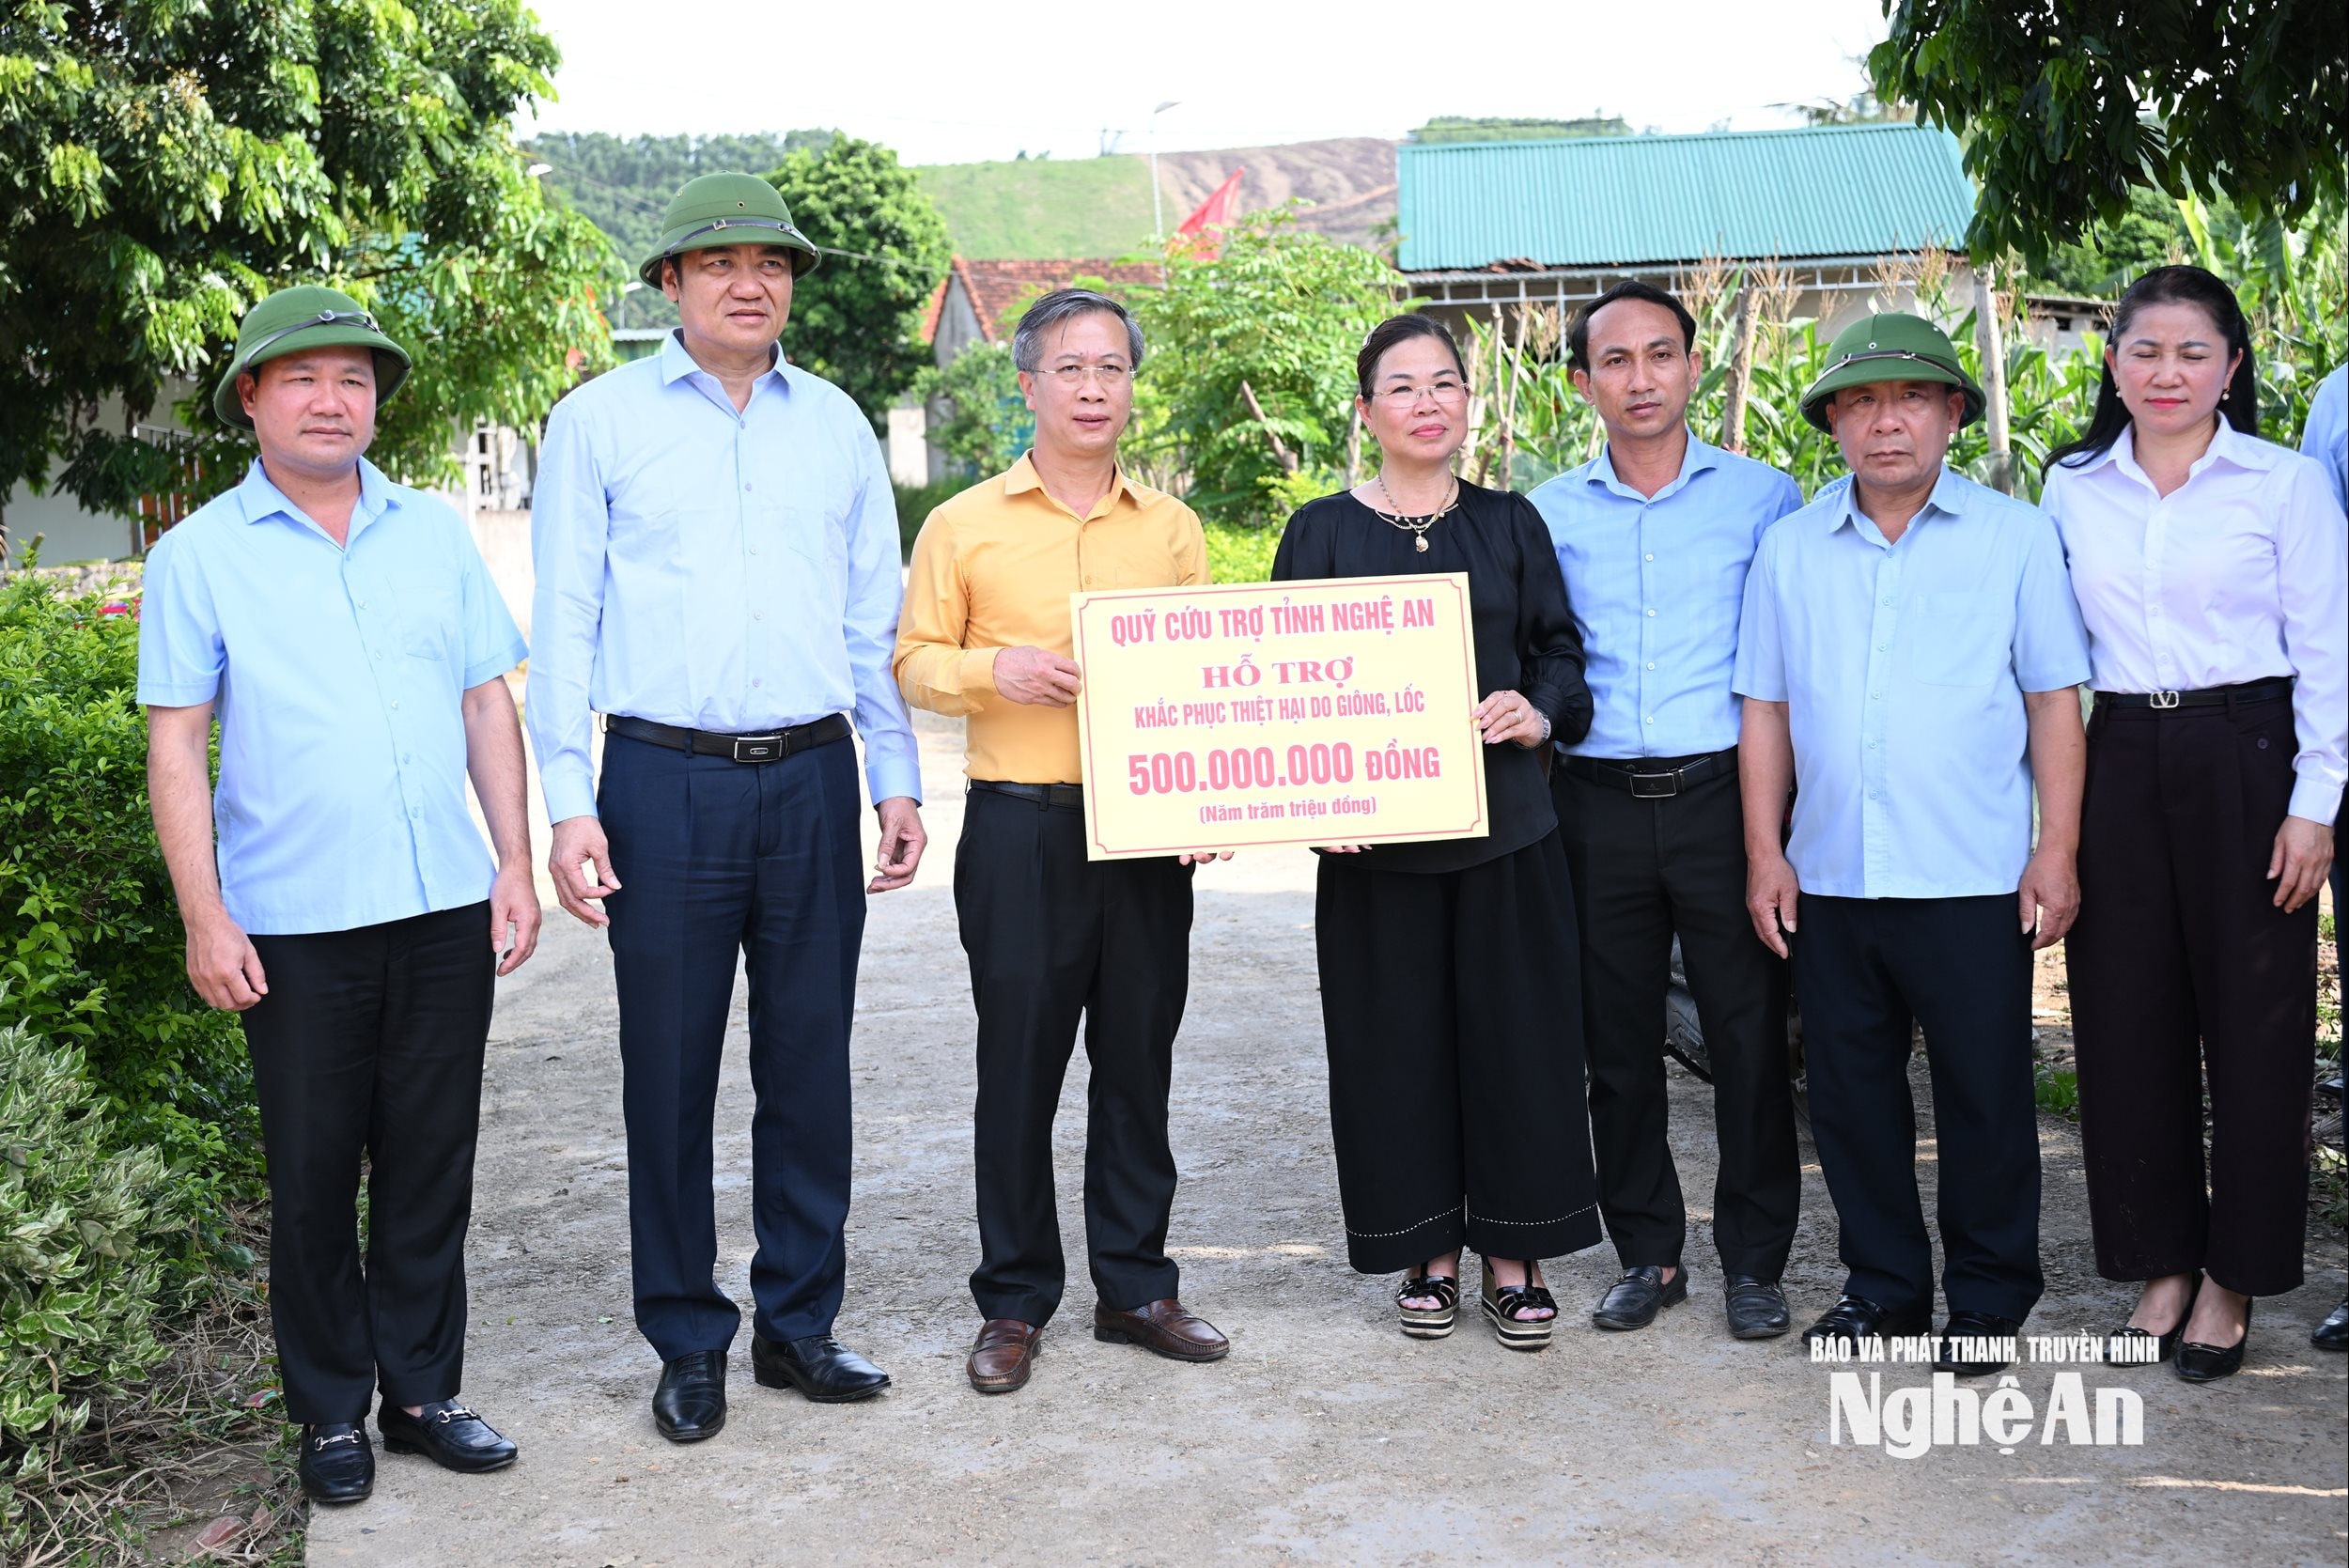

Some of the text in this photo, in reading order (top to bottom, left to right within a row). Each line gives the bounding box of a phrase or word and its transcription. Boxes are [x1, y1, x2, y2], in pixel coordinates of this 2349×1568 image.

[1112, 595, 1434, 646] QUỸ CỨU TRỢ TỈNH NGHỆ AN
[1203, 654, 1353, 689] HỖ TRỢ
[1135, 684, 1424, 729] KHẮC PHỤC THIỆT HẠI DO GIÔNG, LỐC
[1128, 738, 1440, 797] 500.000.000 ĐỒNG
[1200, 796, 1376, 824] (Năm trăm triệu đồng)
